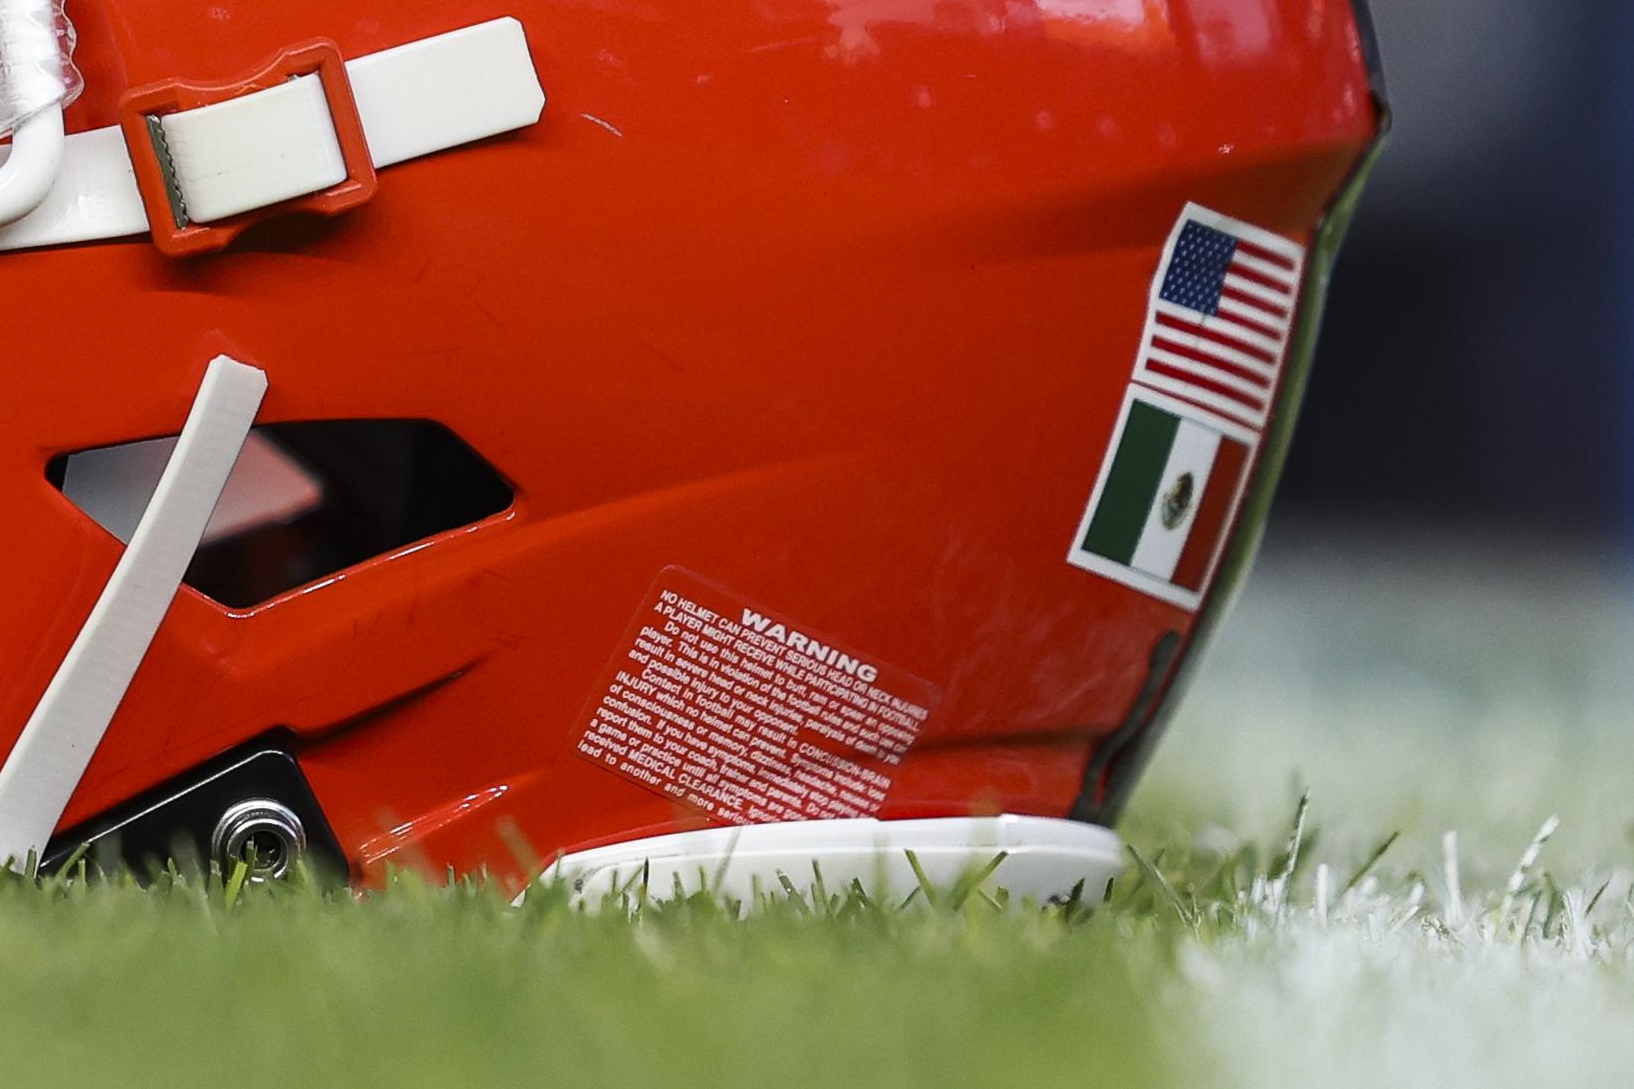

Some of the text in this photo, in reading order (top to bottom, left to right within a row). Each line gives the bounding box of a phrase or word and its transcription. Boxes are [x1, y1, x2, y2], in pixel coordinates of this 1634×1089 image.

[628, 650, 797, 735] and possible injury to your opponent.
[635, 638, 664, 656] result
[665, 651, 674, 661] in
[675, 658, 708, 677] severe
[709, 672, 734, 689] head
[733, 685, 744, 695] or
[745, 691, 769, 706] neck
[769, 700, 803, 725] injuries,
[805, 719, 844, 741] paralysis
[640, 627, 671, 647] player.
[676, 642, 698, 658] This
[698, 653, 709, 663] is
[709, 658, 719, 668] in
[720, 665, 759, 688] violation
[759, 684, 772, 693] of
[770, 687, 786, 700] the
[787, 694, 821, 715] football
[820, 711, 842, 725] rules
[842, 721, 860, 733] and
[859, 729, 880, 742] such
[879, 738, 894, 748] use
[654, 601, 664, 611] A
[663, 605, 702, 630] PLAYER
[701, 625, 734, 646] MIGHT
[733, 640, 775, 665] RECEIVE
[774, 659, 805, 679] WHILE
[804, 673, 869, 708] PARTICIPATING
[867, 701, 879, 712] IN
[660, 590, 927, 720] NO HELMET CAN PREVENT SERIOUS HEAD OR NECK INJURIES
[664, 621, 914, 745] Do not use this helmet to butt, ram or spear an opposing
[737, 609, 879, 683] WARNING
[596, 708, 627, 726] report
[627, 721, 652, 738] them
[653, 733, 664, 744] to
[663, 740, 687, 755] your
[687, 751, 718, 772] coach,
[719, 764, 749, 783] trainer
[749, 779, 768, 791] and
[806, 803, 819, 815] Do
[602, 696, 651, 724] confusion.
[656, 719, 666, 730] If
[663, 725, 683, 738] you
[684, 732, 708, 750] have
[757, 767, 809, 798] immediately
[809, 791, 829, 807] stop
[609, 684, 622, 694] of
[621, 690, 695, 729] consciousness
[869, 803, 879, 812] or
[616, 671, 656, 696] INJURY
[655, 692, 685, 710] which
[685, 706, 699, 717] no
[699, 711, 733, 732] helmet
[732, 728, 750, 741] can
[750, 737, 785, 758] prevent.
[790, 753, 833, 778] Symptoms
[866, 787, 884, 800] loss
[641, 669, 682, 694] Contact
[682, 689, 693, 700] in
[695, 695, 734, 719] football
[735, 715, 755, 732] may
[758, 726, 786, 743] result
[787, 738, 797, 748] in
[577, 740, 602, 757] lead
[604, 753, 617, 765] to
[620, 762, 661, 786] another
[664, 783, 685, 797] and
[687, 794, 714, 811] more
[584, 731, 627, 755] received
[628, 749, 678, 779] MEDICAL
[677, 773, 742, 810] CLEARANCE.
[590, 719, 597, 727] a
[597, 723, 627, 741] game
[628, 737, 640, 747] or
[640, 743, 681, 766] practice
[682, 763, 706, 777] until
[705, 774, 719, 784] all
[718, 780, 767, 806] symptoms
[767, 802, 783, 813] are
